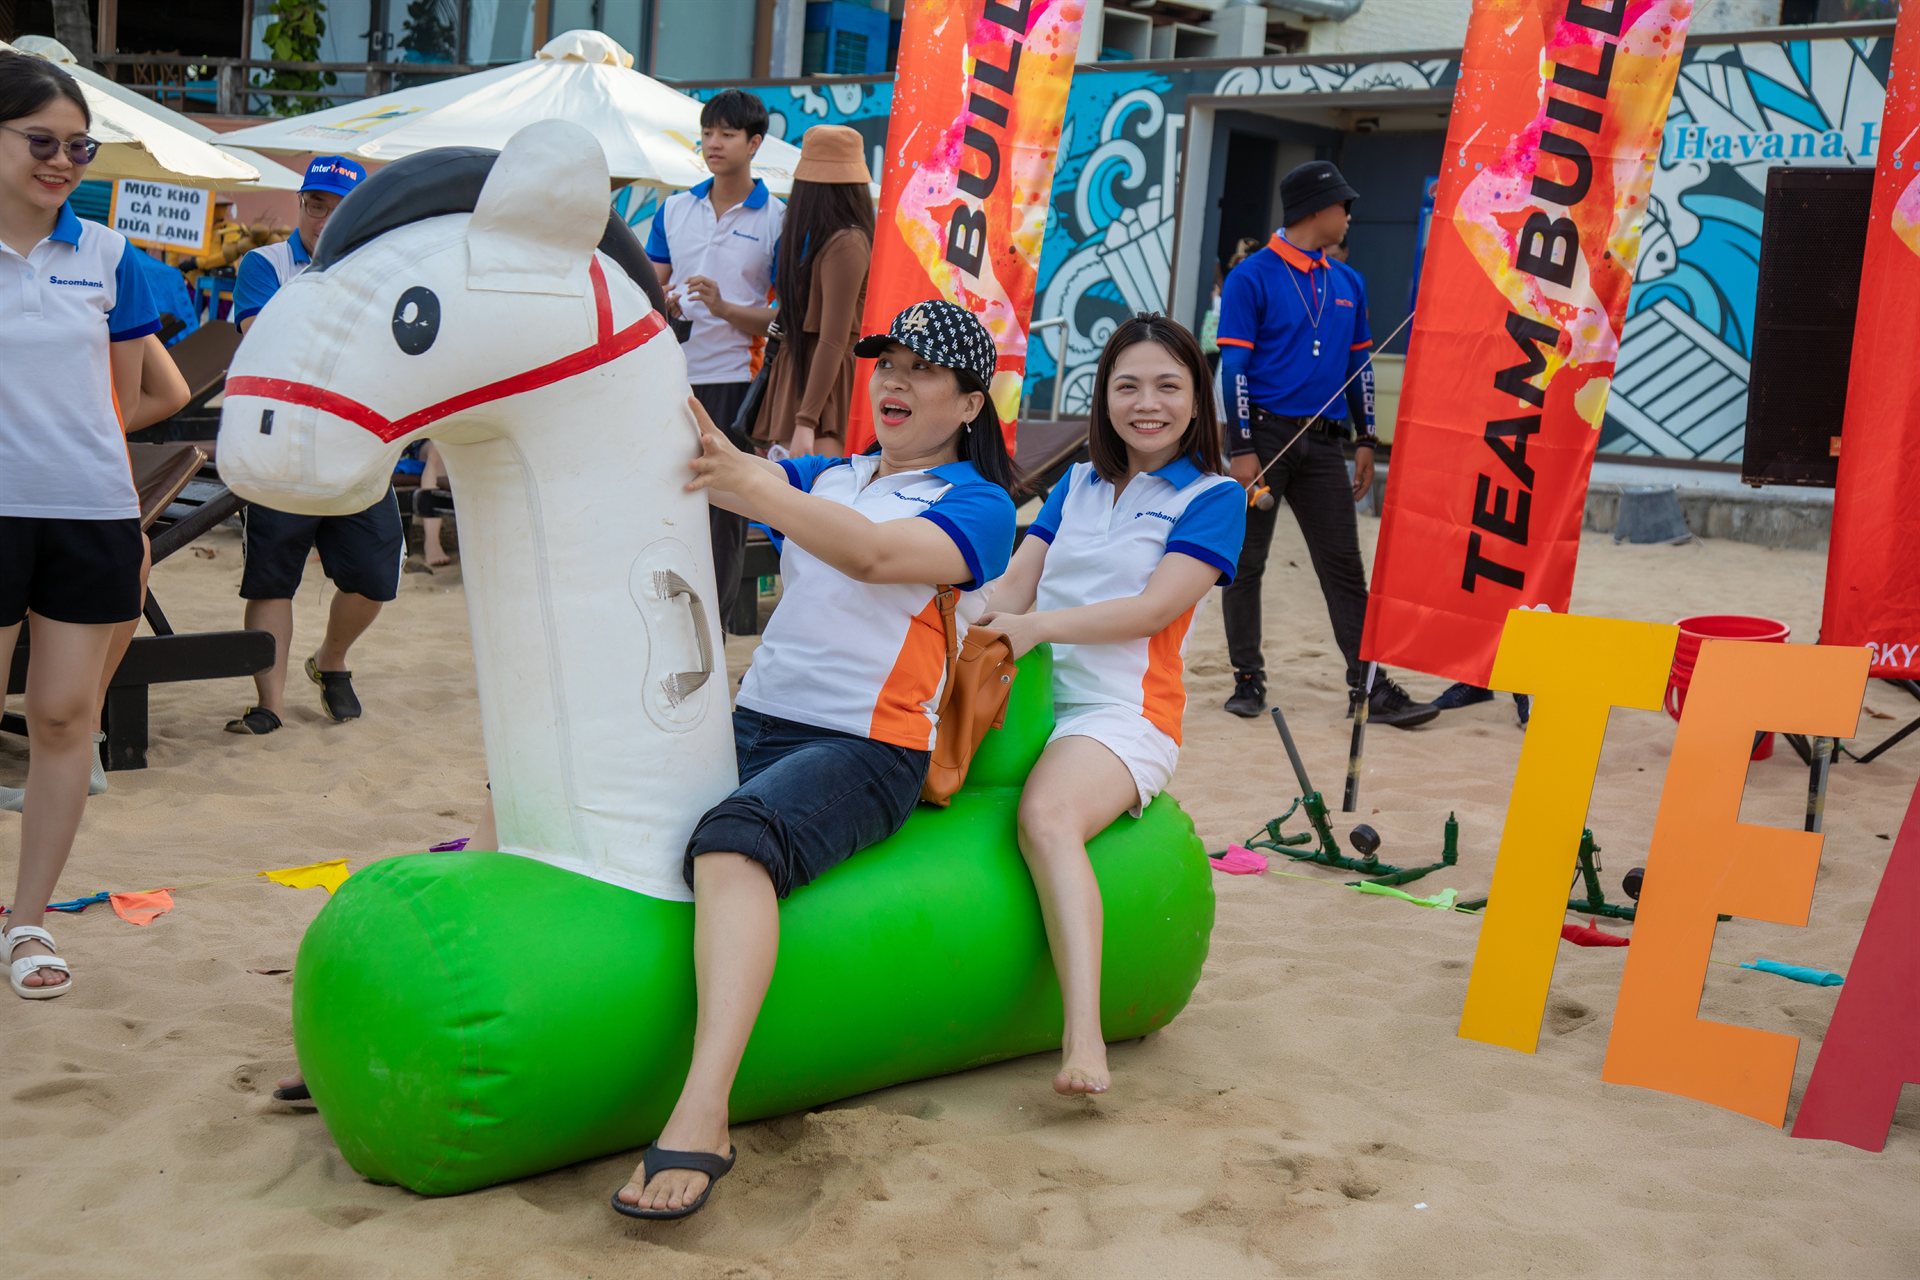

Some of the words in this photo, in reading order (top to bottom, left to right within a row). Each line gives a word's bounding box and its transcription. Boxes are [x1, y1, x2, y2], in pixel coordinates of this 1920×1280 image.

[1673, 125, 1844, 160] Havana
[167, 188, 200, 205] KHÔ
[158, 205, 191, 221] KHÔ
[49, 275, 104, 289] Sacombank
[1461, 311, 1560, 594] TEAM
